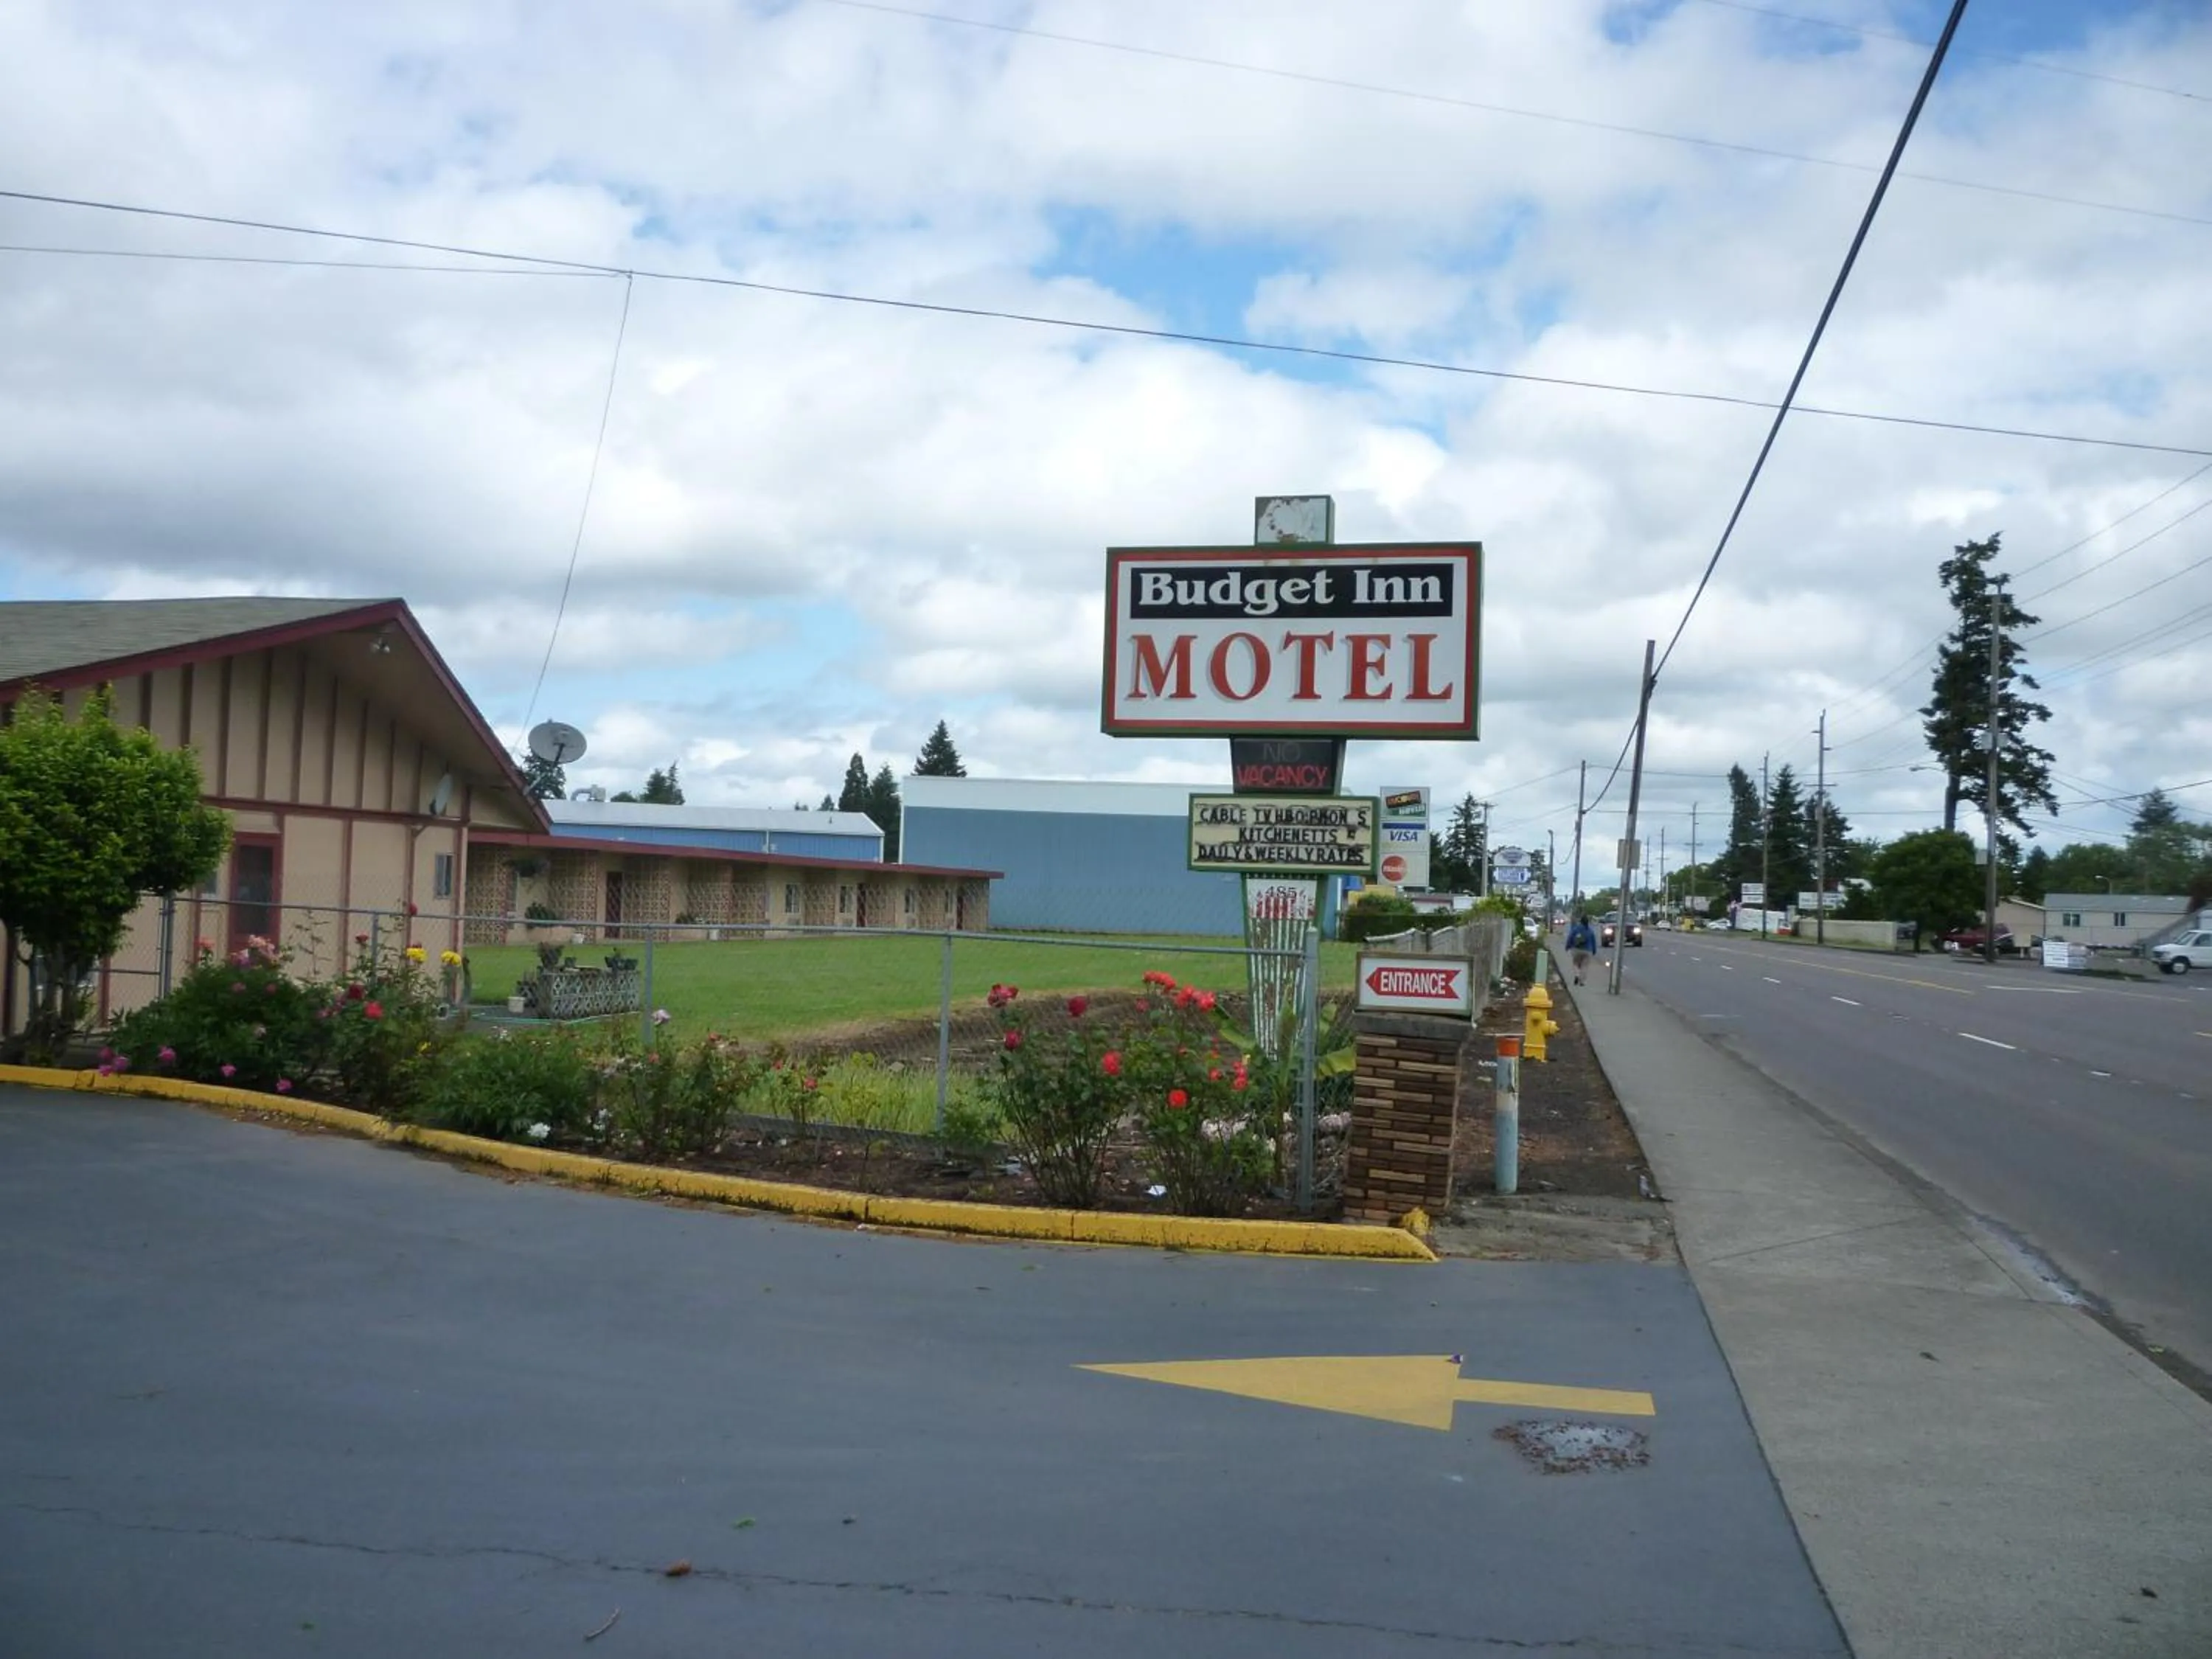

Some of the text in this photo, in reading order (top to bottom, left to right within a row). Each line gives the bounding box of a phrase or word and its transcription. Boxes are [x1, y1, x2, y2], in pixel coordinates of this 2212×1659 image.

[1138, 569, 1444, 616] Budget Inn
[1127, 630, 1453, 701] MOTEL
[1262, 740, 1301, 763] NO
[1237, 764, 1328, 787] VACANCY
[1390, 830, 1418, 841] VISA
[1380, 970, 1447, 995] ENTRANCE
